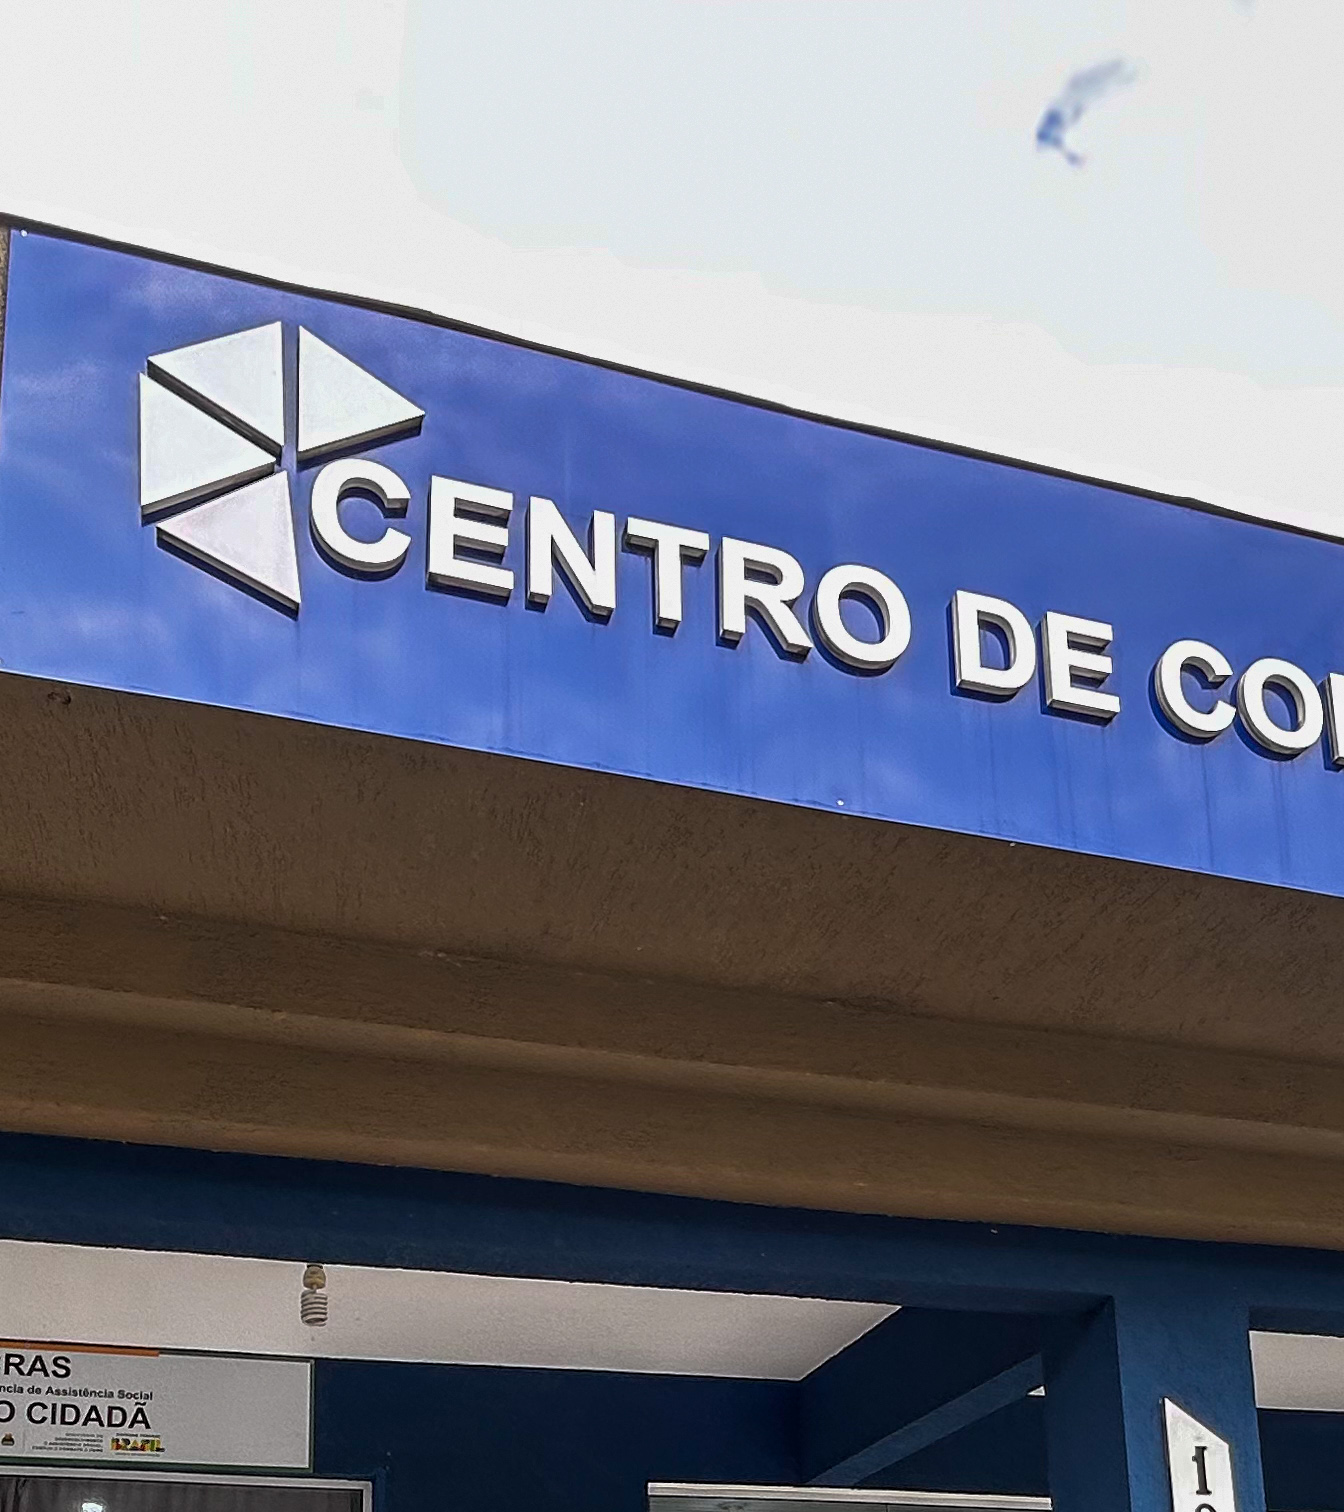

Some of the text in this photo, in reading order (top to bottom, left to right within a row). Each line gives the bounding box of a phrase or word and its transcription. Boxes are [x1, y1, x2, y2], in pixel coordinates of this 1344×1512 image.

[309, 457, 913, 675] CENTRO
[951, 588, 1122, 722] DE
[27, 1384, 42, 1396] de
[45, 1386, 115, 1400] Assistência
[117, 1389, 154, 1401] Social
[26, 1400, 152, 1430] CIDADÃ
